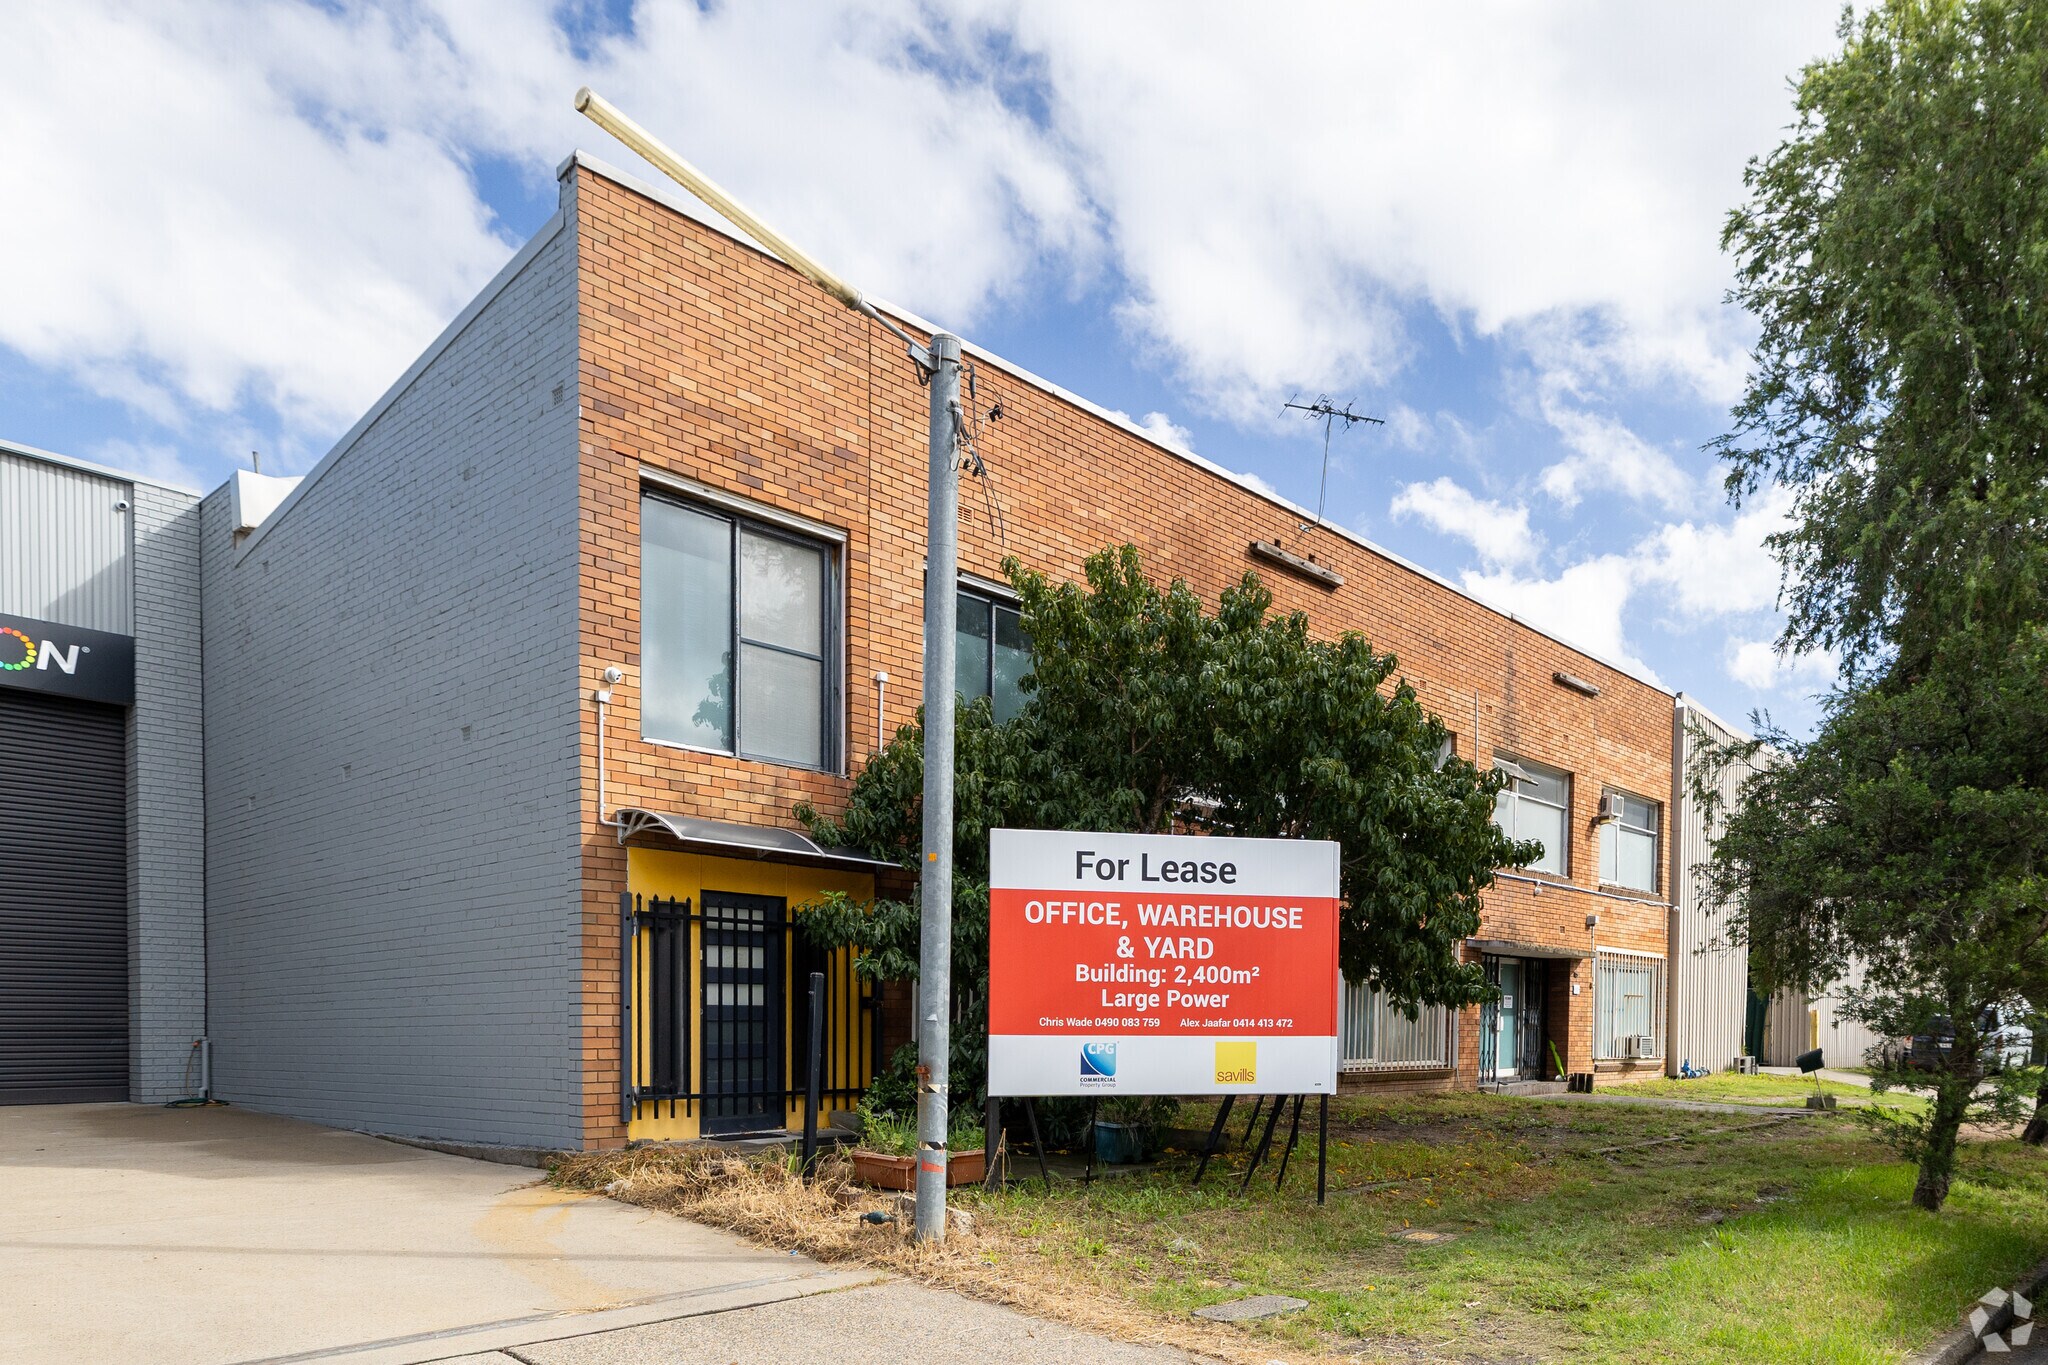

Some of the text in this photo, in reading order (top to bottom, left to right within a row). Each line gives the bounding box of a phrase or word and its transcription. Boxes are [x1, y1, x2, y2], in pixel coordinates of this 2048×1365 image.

[1075, 850, 1237, 884] For Lease
[1024, 900, 1303, 930] OFFICE, WAREHOUSE
[1116, 936, 1214, 960] & YARD
[1075, 963, 1166, 988] Building:
[1101, 989, 1230, 1012] Large Power
[1039, 1016, 1160, 1027] Chris Wade 0490 083 759
[1180, 1017, 1293, 1028] Alex Jaafar 0414 413 472
[1088, 1043, 1115, 1055] CPG
[1217, 1068, 1254, 1082] savills
